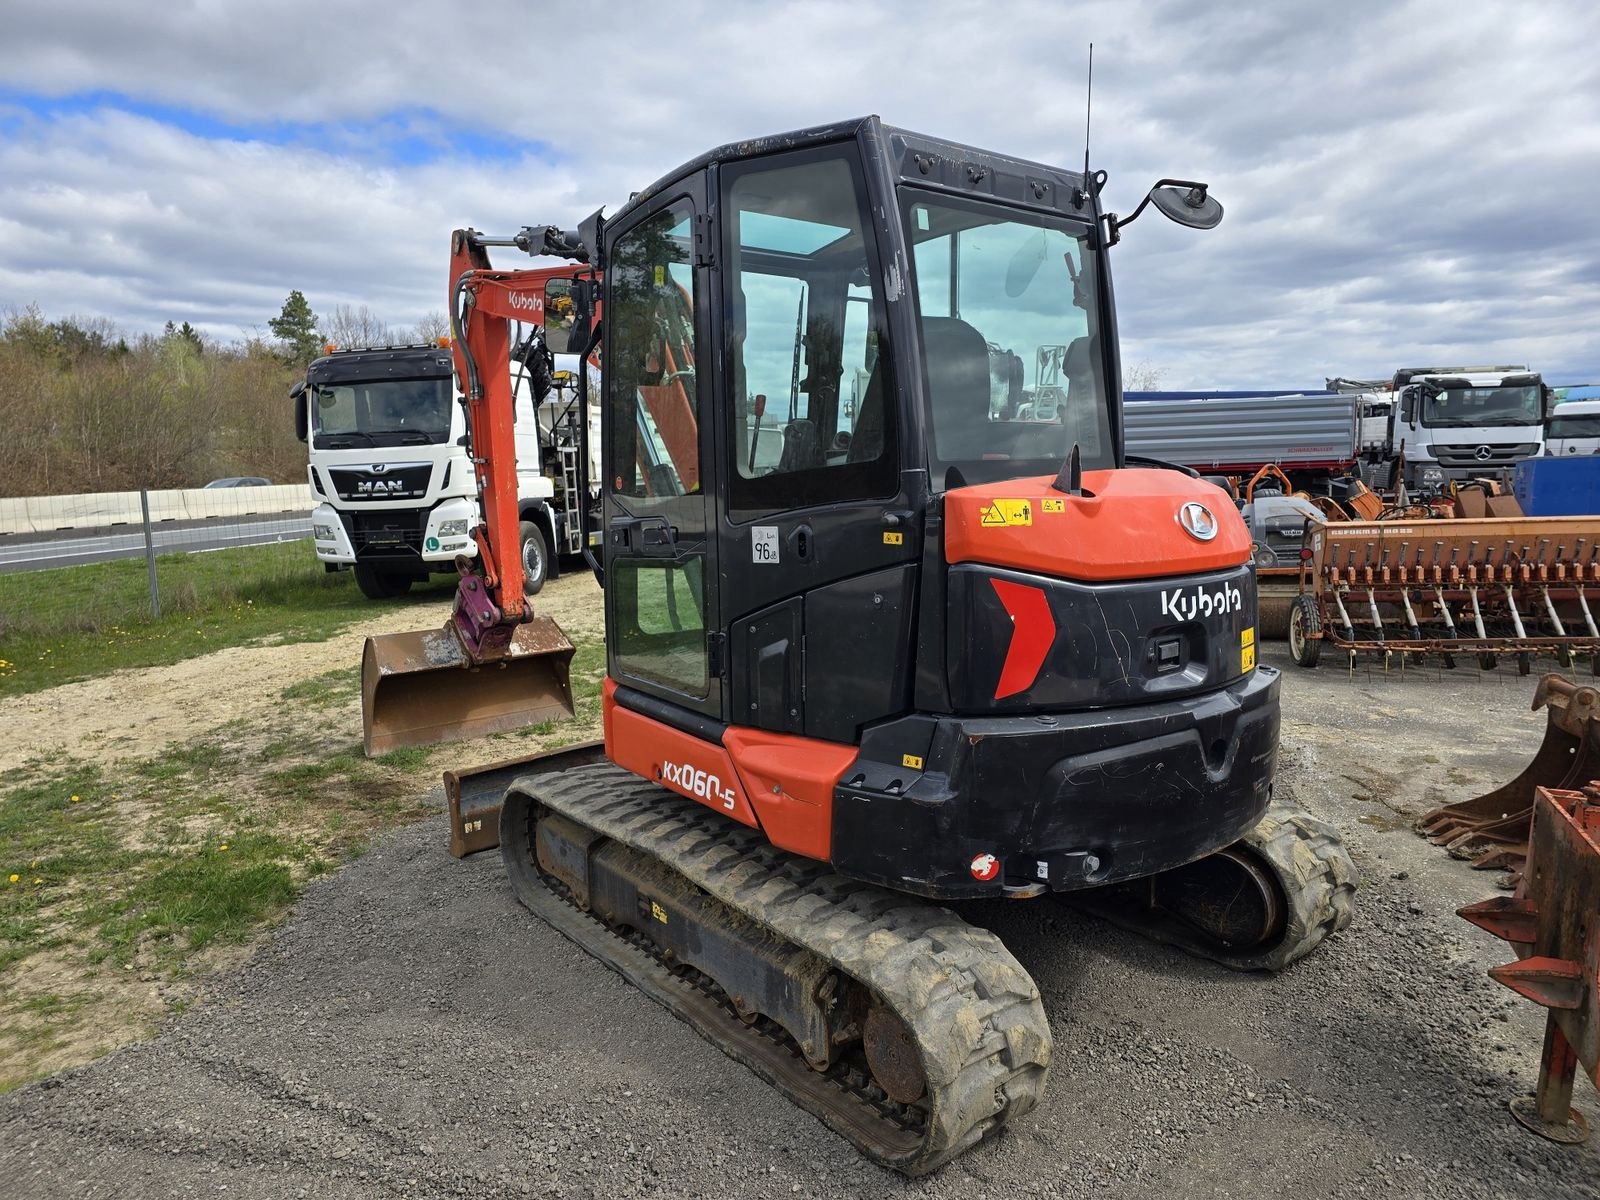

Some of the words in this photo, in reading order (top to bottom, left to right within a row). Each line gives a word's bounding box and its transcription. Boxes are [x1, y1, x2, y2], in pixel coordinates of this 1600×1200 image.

[508, 291, 543, 312] Kubota
[357, 480, 403, 493] MAN
[429, 538, 437, 549] L
[755, 542, 770, 560] 96
[1161, 581, 1242, 622] Kubota
